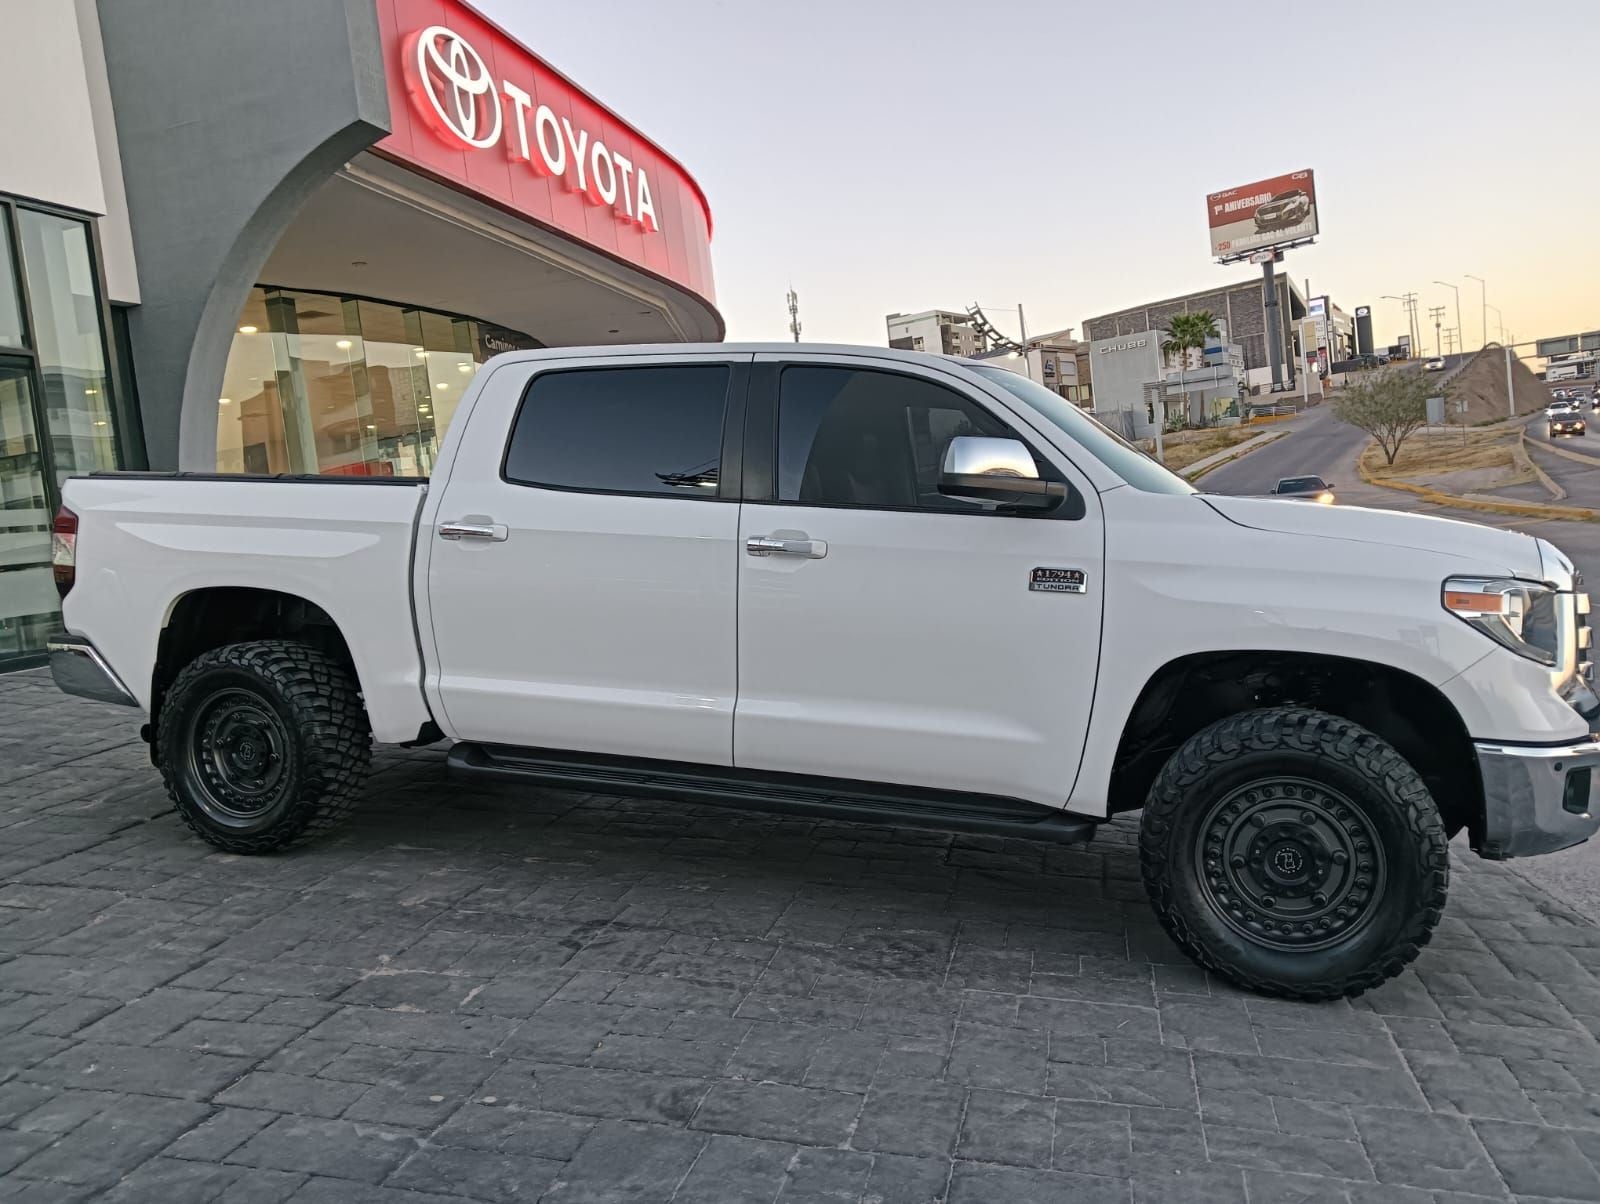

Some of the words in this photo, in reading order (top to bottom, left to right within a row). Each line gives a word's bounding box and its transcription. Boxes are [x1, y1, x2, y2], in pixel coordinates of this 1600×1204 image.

[503, 79, 659, 232] TOYOTA
[1224, 192, 1273, 213] ANIVERSARIO
[1099, 339, 1146, 354] CHUBB
[1045, 570, 1071, 578] 1794
[1037, 583, 1080, 591] TUNDRA
